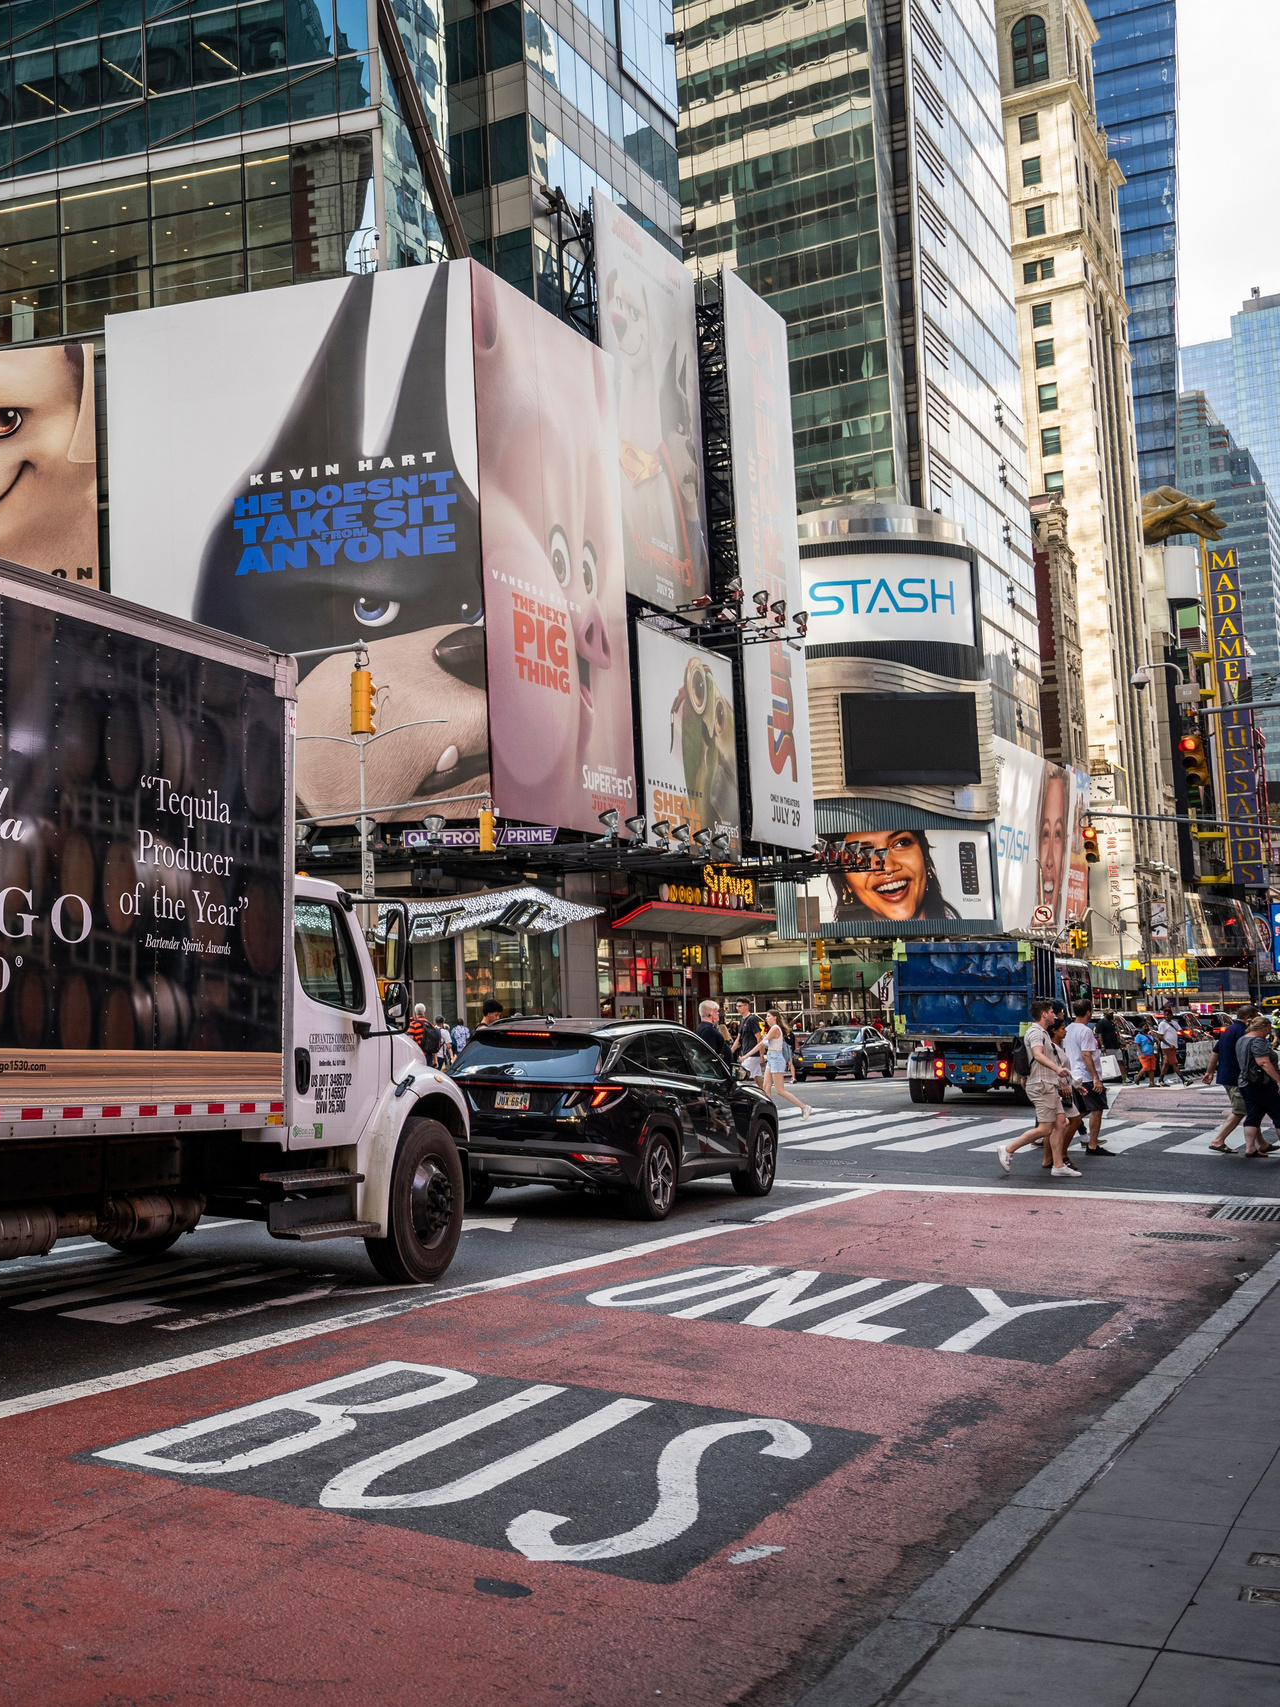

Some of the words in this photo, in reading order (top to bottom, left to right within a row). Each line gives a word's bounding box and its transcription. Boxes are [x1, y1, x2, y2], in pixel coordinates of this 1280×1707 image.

[250, 463, 340, 486] KEVIN
[358, 451, 436, 471] HART
[234, 492, 283, 517] HE
[290, 470, 454, 510] DOESN'T
[233, 505, 362, 544] TAKE
[373, 494, 457, 529] SIT
[321, 527, 368, 542] FROM
[235, 523, 456, 576] ANYONE
[492, 569, 544, 598] VANESSA
[550, 593, 581, 613] BAYER
[512, 592, 535, 615] THE
[537, 602, 567, 626] NEXT
[808, 578, 955, 617] STASH
[1211, 549, 1242, 681] MADAME
[513, 610, 569, 670] PIG
[515, 654, 570, 694] THING
[648, 779, 677, 792] NATASHA
[653, 790, 701, 821] SHELL
[772, 810, 789, 825] JULY
[791, 813, 800, 827] 29
[137, 829, 233, 877] Producer
[508, 830, 552, 842] PRIME
[997, 825, 1030, 864] STASH
[366, 871, 373, 884] 25
[120, 882, 145, 916] of
[153, 885, 185, 921] the
[145, 933, 180, 951] Bartender
[181, 937, 204, 955] Spirits
[205, 940, 231, 955] Awards
[309, 1033, 334, 1044] CERVANTES
[335, 1033, 355, 1044] COMPANY
[311, 1074, 318, 1088] US
[319, 1074, 329, 1087] DOT
[314, 1088, 323, 1100] MC
[316, 1101, 327, 1114] GVW
[584, 1264, 1112, 1353] ONLY
[92, 1360, 812, 1562] BUS
